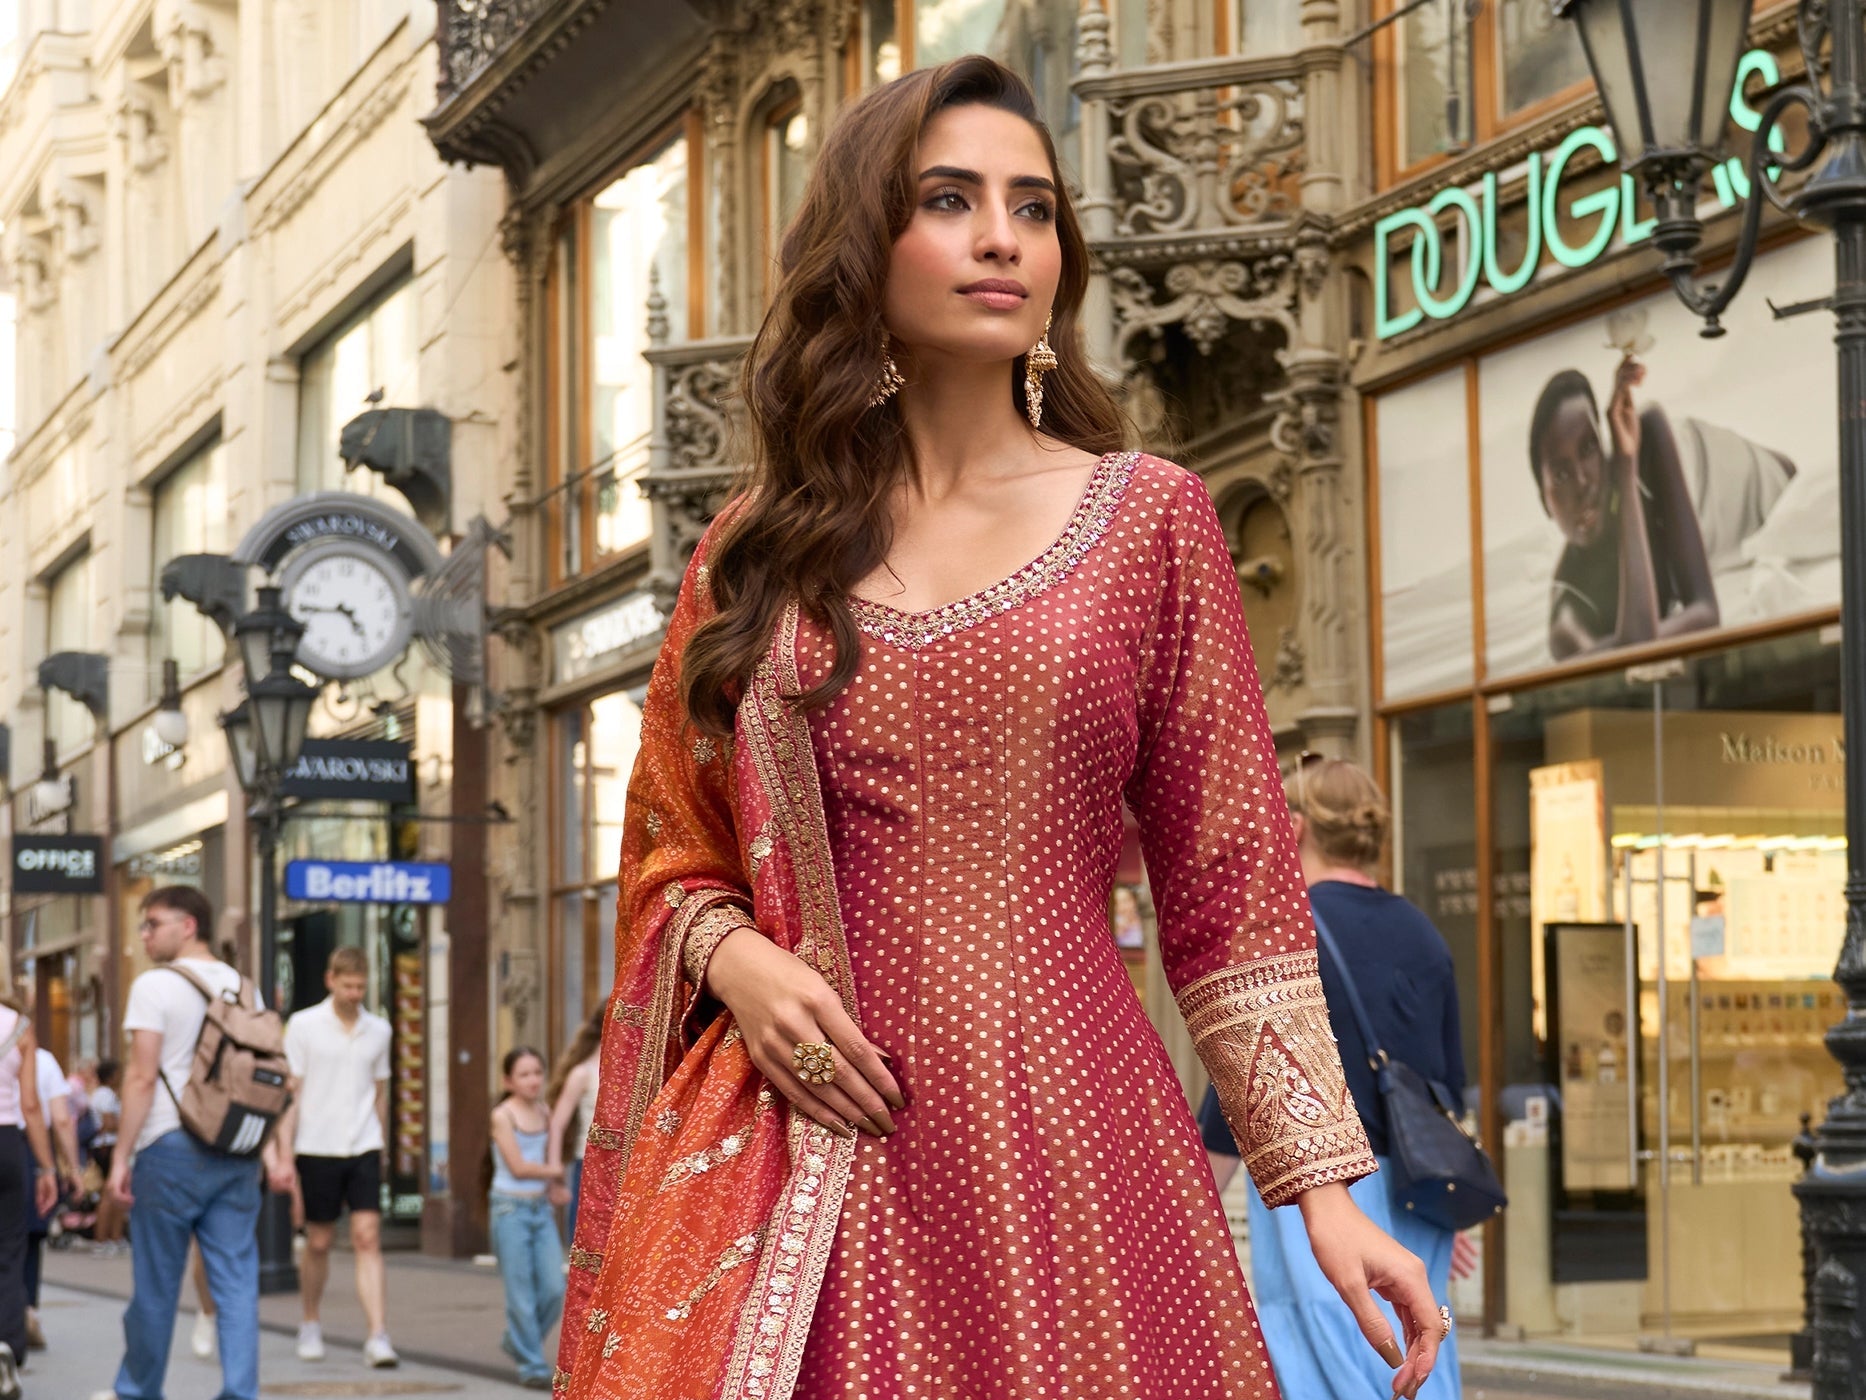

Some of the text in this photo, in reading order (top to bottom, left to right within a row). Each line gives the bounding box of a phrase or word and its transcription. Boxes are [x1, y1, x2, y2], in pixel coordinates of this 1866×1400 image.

[1374, 49, 1784, 339] DOUGLS
[1721, 732, 1825, 764] Maison
[17, 849, 94, 871] OFFICE
[306, 865, 432, 902] Berlitz
